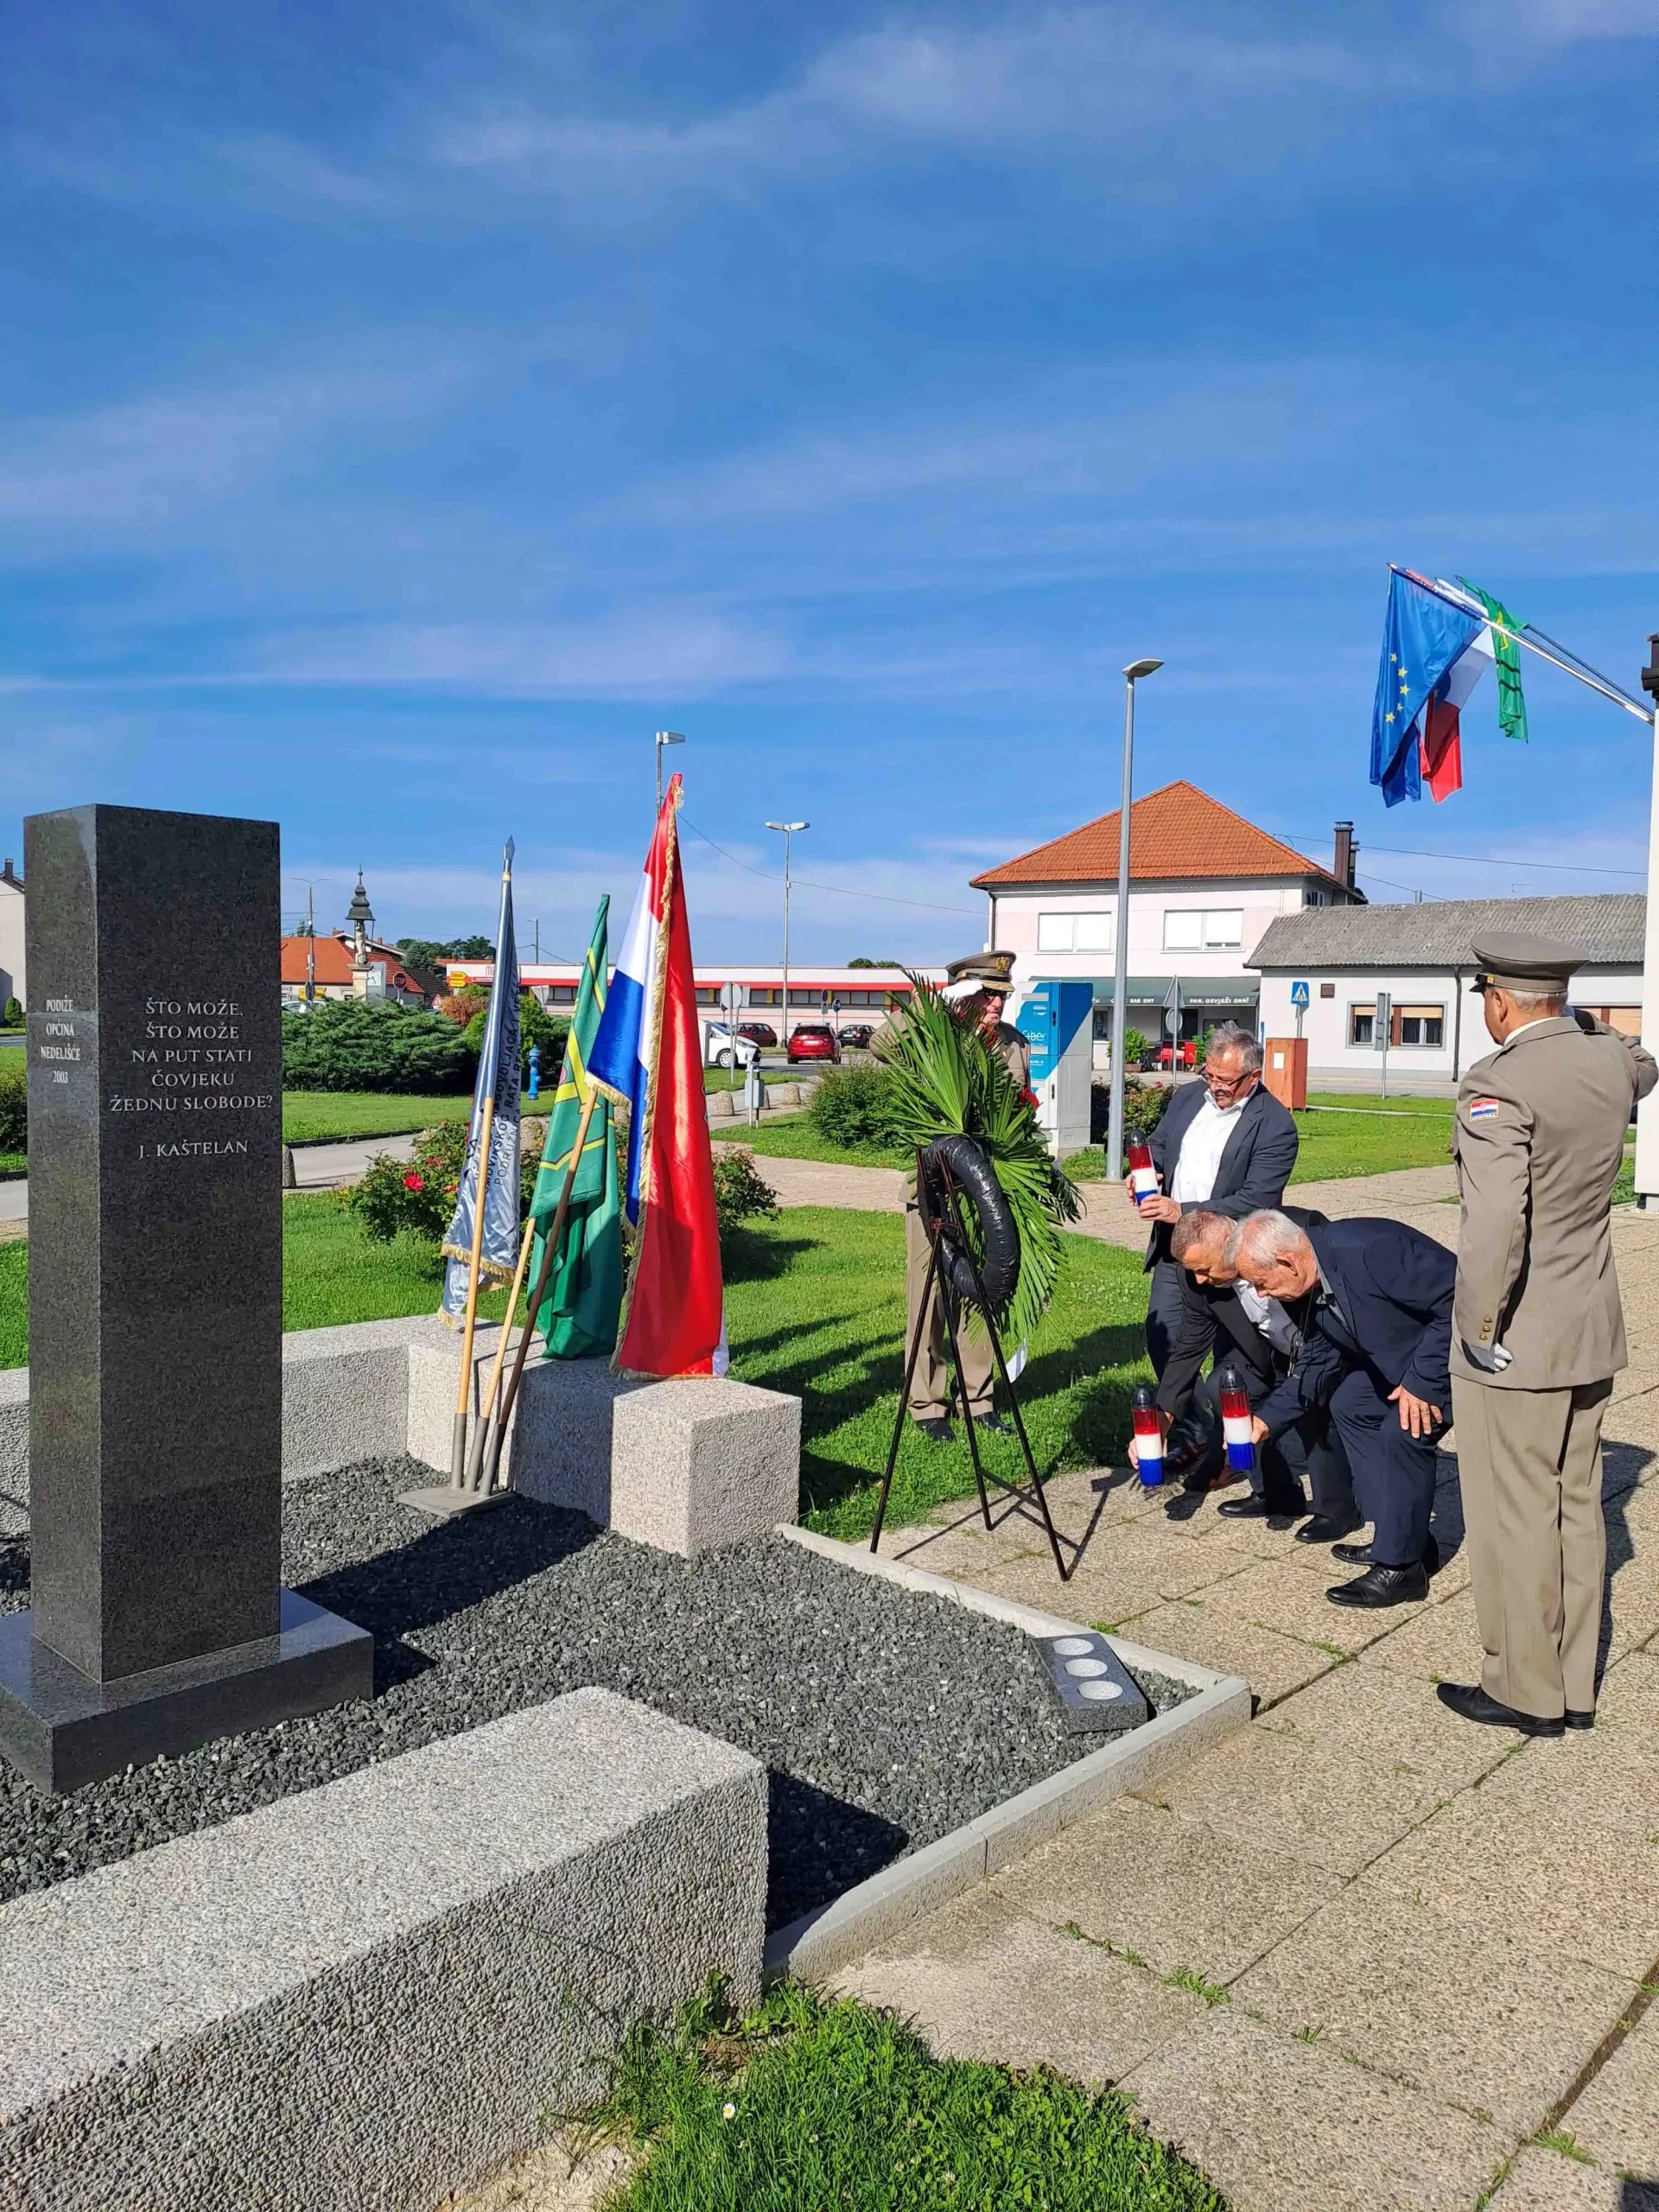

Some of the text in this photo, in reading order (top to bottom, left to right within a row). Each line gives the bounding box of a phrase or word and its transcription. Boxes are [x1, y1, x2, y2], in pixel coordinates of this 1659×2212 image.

[46, 995, 73, 1012] PODIŽE
[145, 997, 181, 1014] ŠTO
[46, 1019, 74, 1036] OPĆINA
[145, 1021, 239, 1039] ŠTO MOŽE
[41, 1043, 80, 1060] NEDELIŠĆE
[131, 1049, 252, 1063] NA PUT STATI
[53, 1071, 68, 1084] 2003
[151, 1069, 235, 1089] ČOVJEKU
[504, 1077, 520, 1109] RATA
[110, 1095, 273, 1112] ŽEDNU SLOBODE?
[137, 1139, 248, 1160] J. KAŠTELAN
